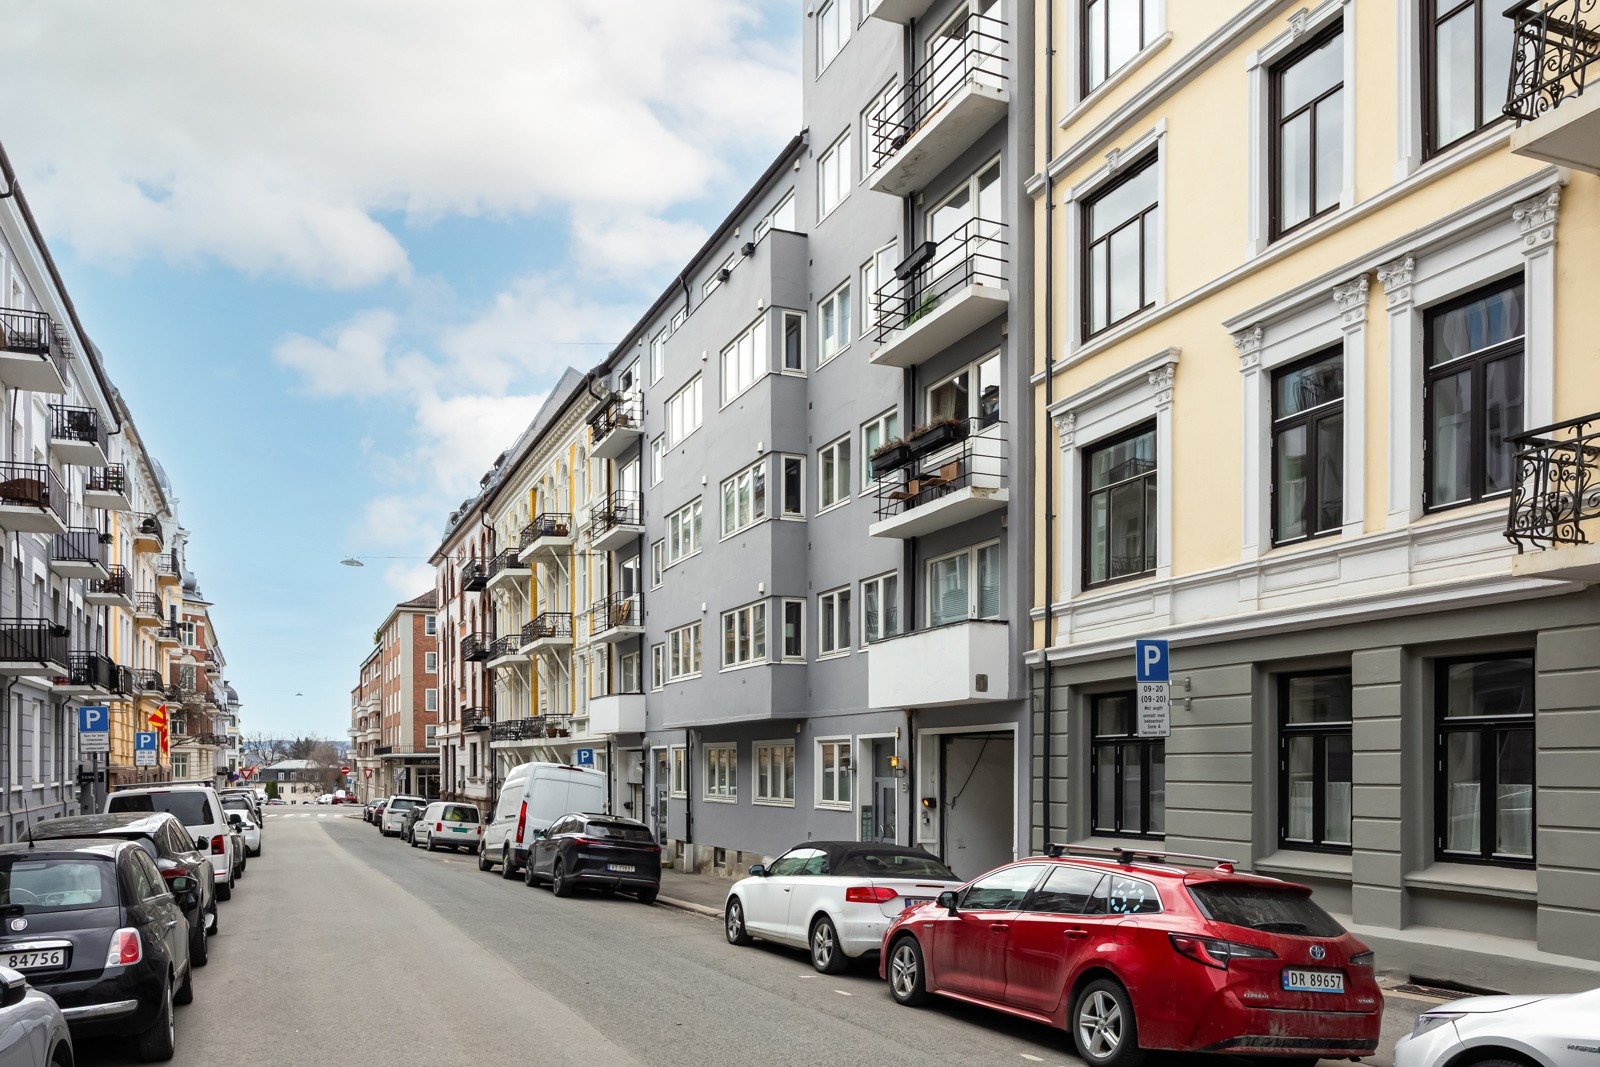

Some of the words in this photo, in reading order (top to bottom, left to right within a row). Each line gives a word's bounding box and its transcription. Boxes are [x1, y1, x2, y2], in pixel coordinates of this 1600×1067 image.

[1144, 645, 1161, 676] P
[86, 710, 100, 729] P
[140, 735, 152, 748] P
[581, 750, 590, 763] P
[8, 951, 60, 968] 84756
[1291, 972, 1306, 986] DR
[1310, 973, 1342, 988] 89657
